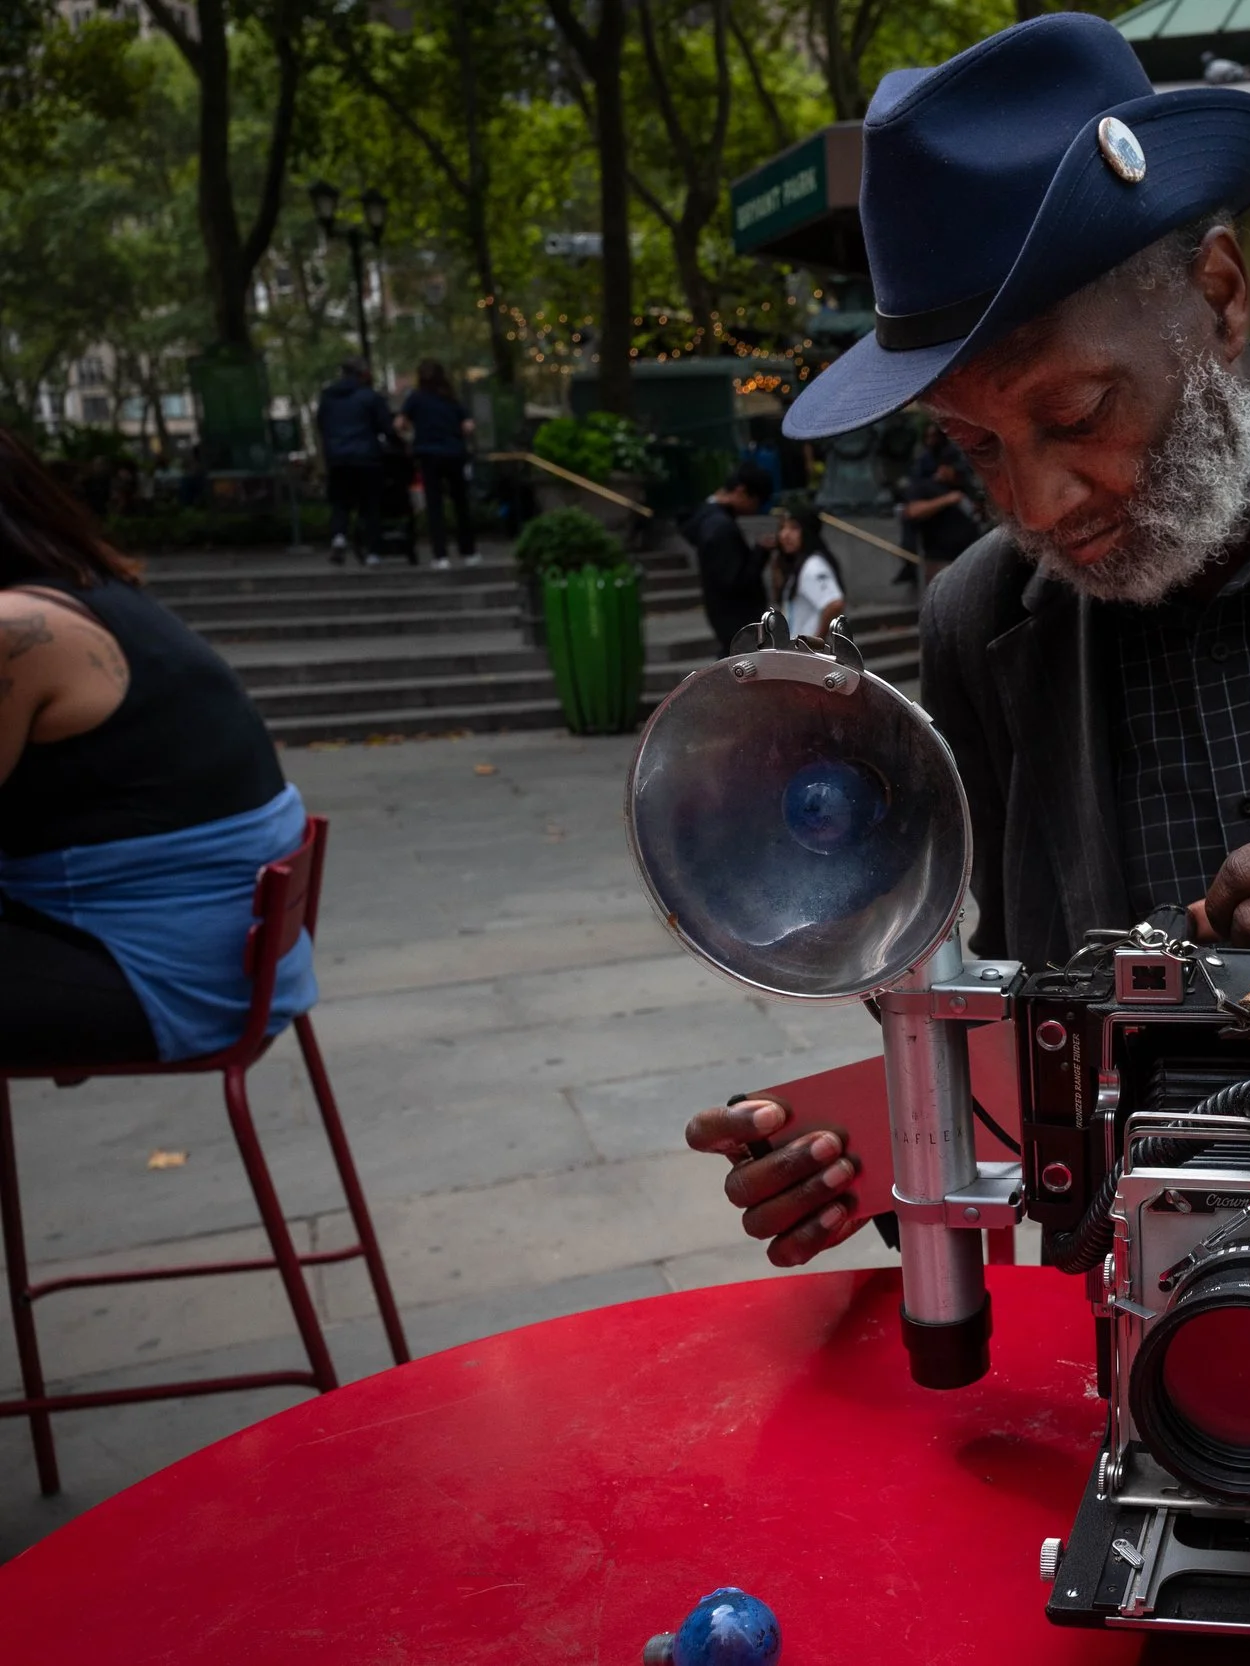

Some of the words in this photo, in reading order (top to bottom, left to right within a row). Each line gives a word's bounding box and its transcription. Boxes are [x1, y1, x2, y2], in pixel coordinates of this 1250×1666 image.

[1072, 1033, 1081, 1062] FINDER
[1073, 1063, 1082, 1091] RANGE
[1205, 1193, 1250, 1208] Crown
